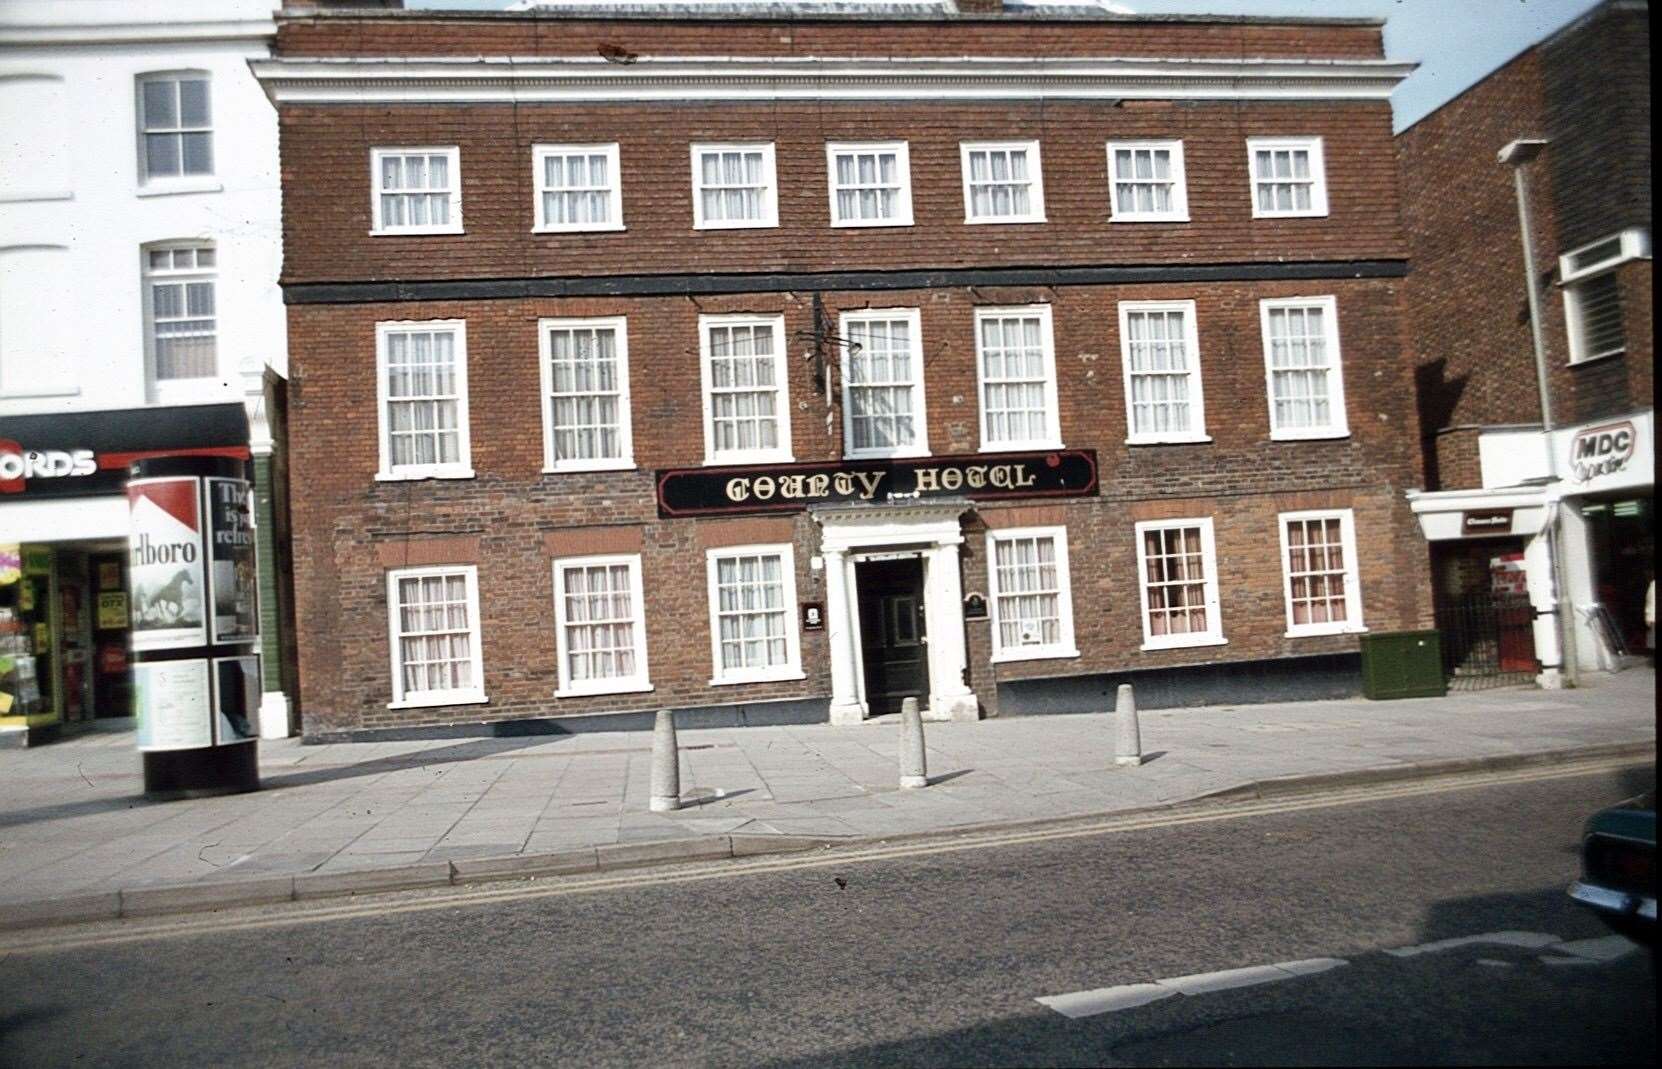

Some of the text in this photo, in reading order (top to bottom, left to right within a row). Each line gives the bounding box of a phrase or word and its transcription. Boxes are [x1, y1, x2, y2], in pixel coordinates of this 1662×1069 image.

[1576, 431, 1630, 459] MDC
[725, 464, 1037, 502] COUNTY HOTEL
